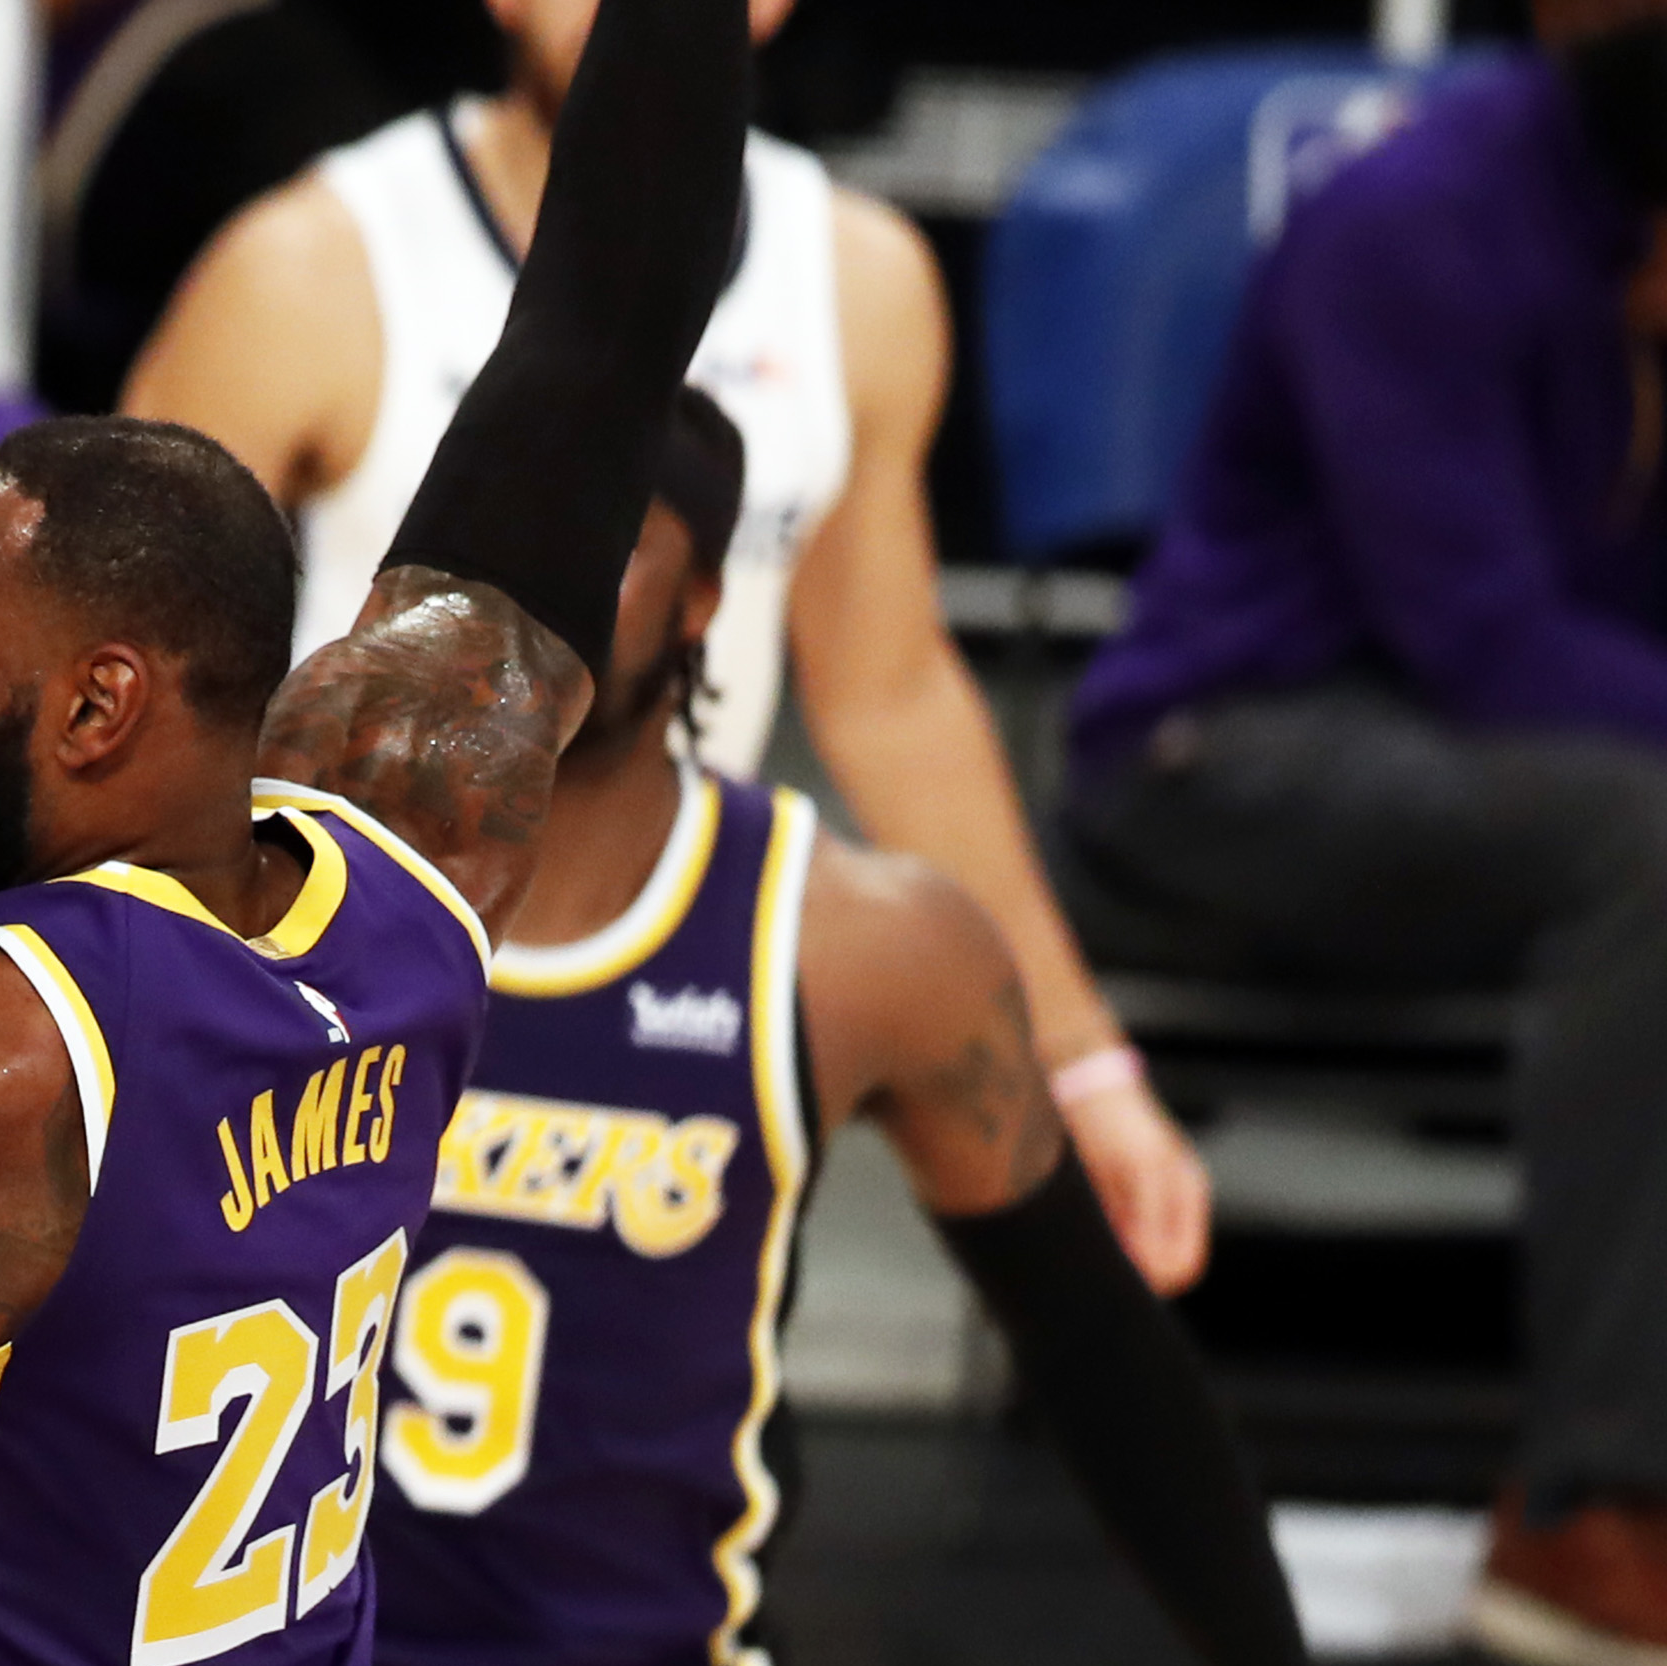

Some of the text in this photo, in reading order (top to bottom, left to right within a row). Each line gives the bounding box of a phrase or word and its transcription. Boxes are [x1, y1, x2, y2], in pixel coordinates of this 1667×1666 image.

[217, 1044, 406, 1233] JAMES
[431, 1089, 739, 1260] KERS
[380, 1247, 550, 1516] 9
